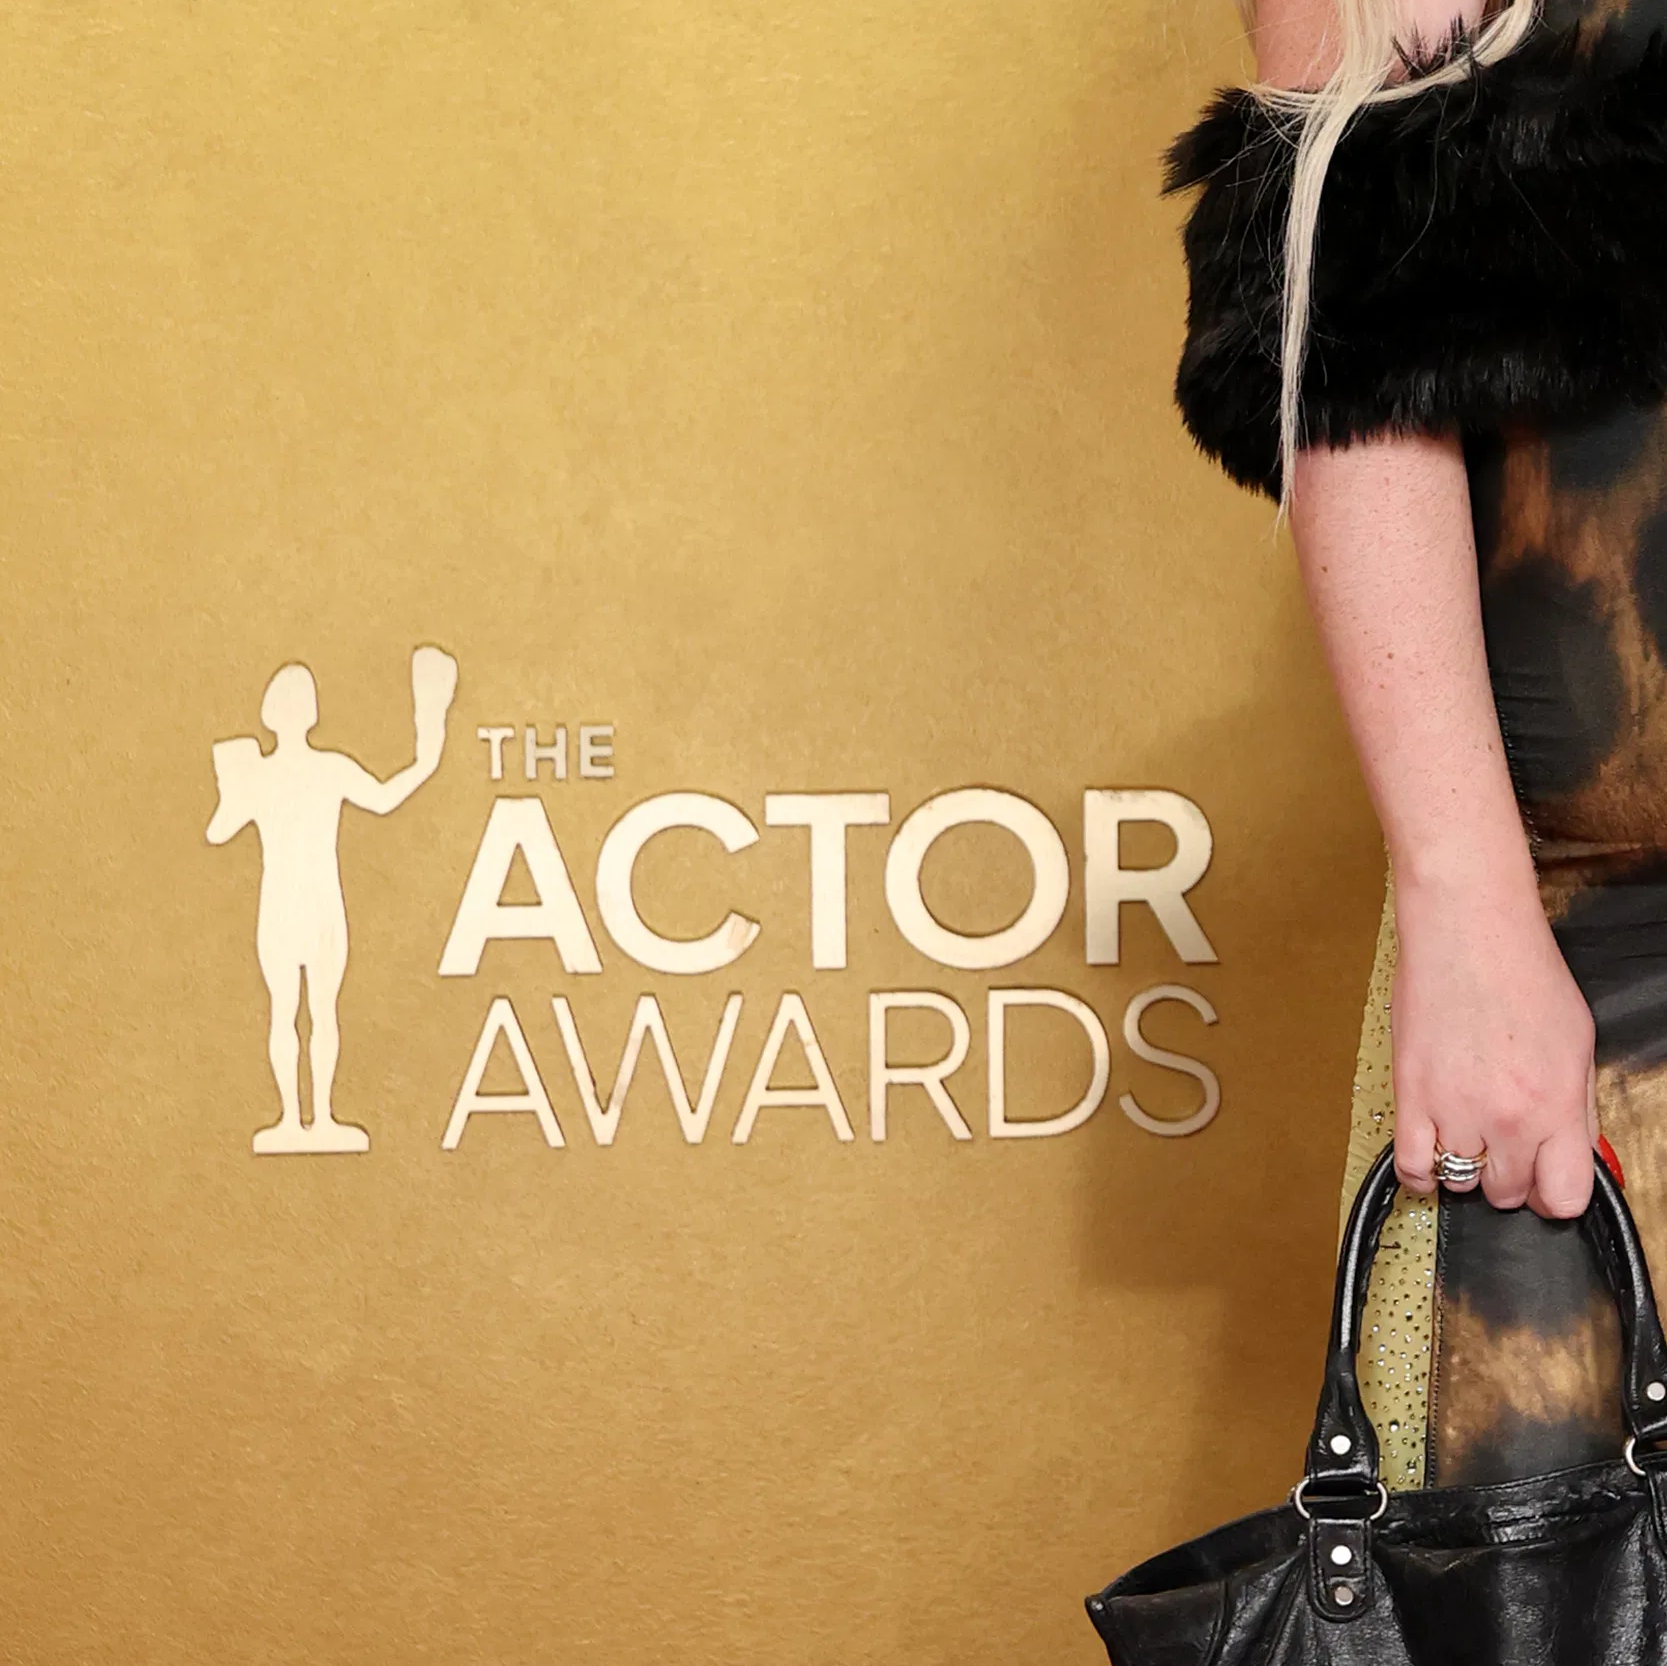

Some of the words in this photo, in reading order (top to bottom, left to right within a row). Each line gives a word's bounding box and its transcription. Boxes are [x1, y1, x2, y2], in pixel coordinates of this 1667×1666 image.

[477, 726, 613, 780] THE
[437, 786, 1219, 976] ACTOR
[441, 983, 1221, 1150] AWARDS
